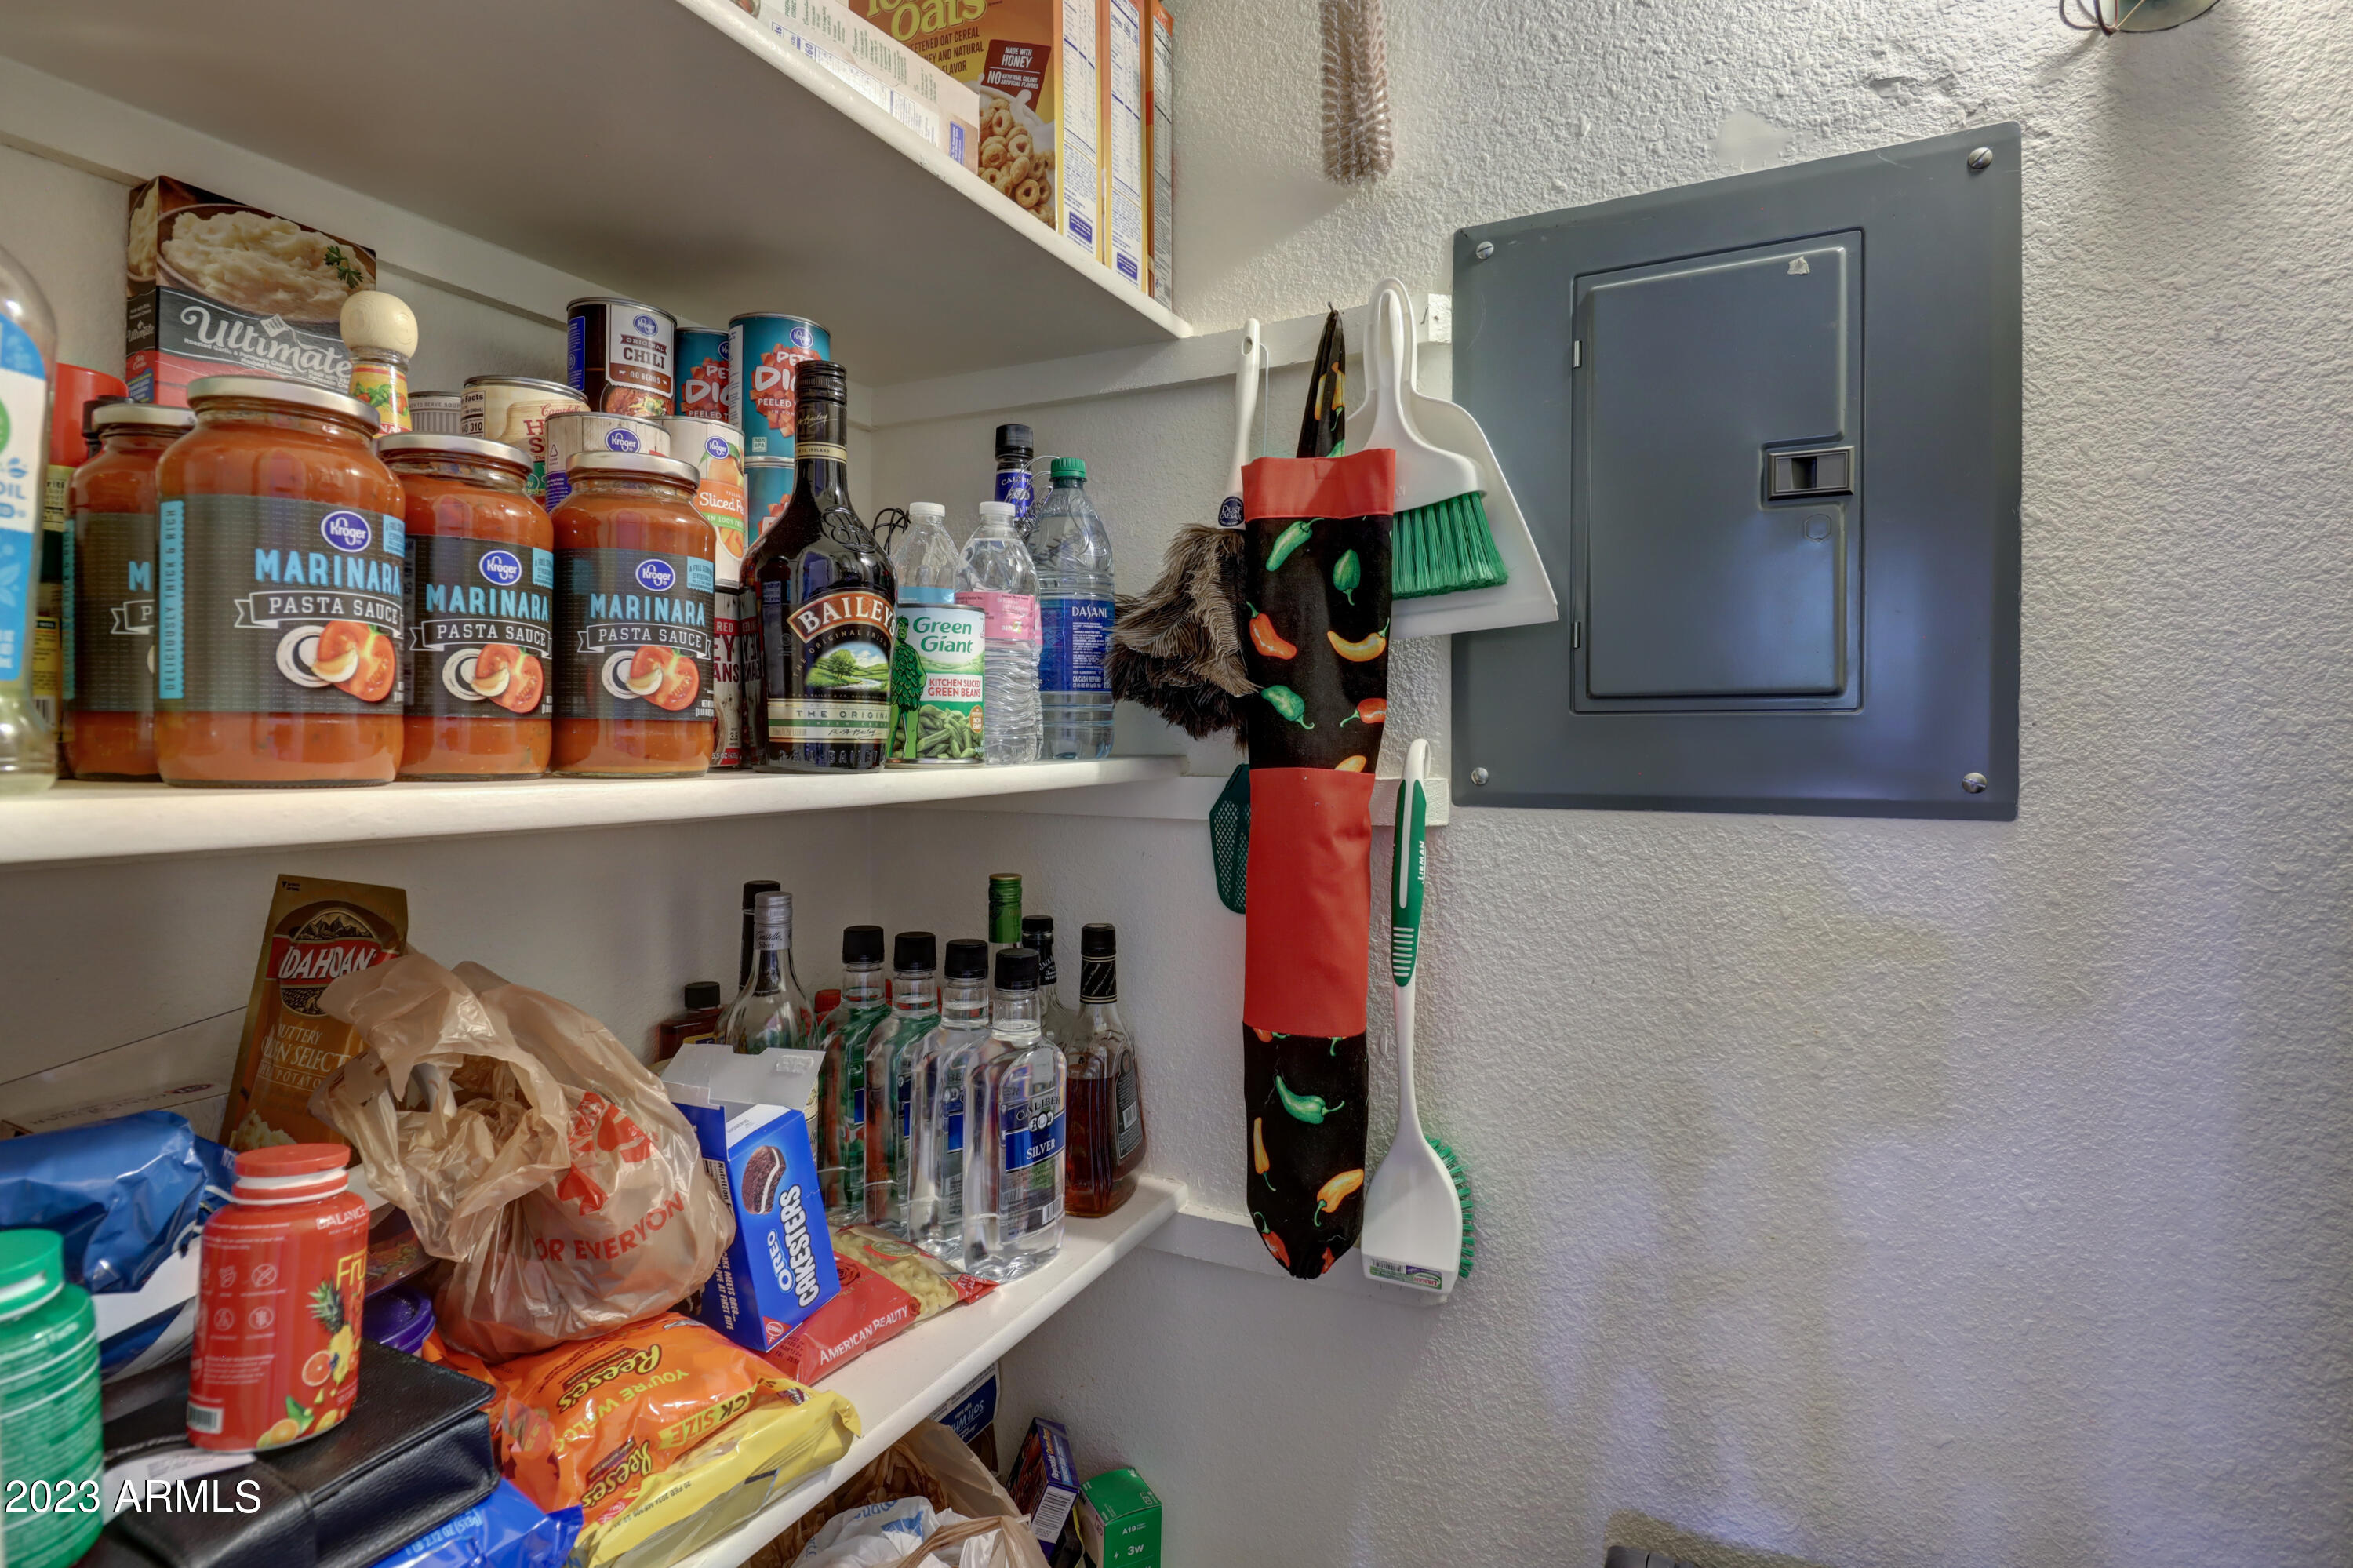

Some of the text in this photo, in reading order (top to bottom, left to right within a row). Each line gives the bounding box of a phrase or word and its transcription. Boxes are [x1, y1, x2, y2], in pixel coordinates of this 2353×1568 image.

[891, 0, 987, 42] Oats
[910, 27, 980, 54] EETENED OAT CEREAL
[1005, 46, 1032, 56] MADE WITH
[922, 42, 984, 64] NEY AND NATURAL
[1001, 54, 1034, 69] HONEY
[943, 60, 968, 75] FLAVOR
[987, 70, 1002, 85] NO
[637, 316, 656, 334] Kroger
[180, 306, 353, 377] Ultimate
[213, 344, 232, 355] Garlic
[625, 337, 665, 352] ORIGINAL
[792, 329, 811, 347] Kroger
[623, 347, 665, 369] CHILI
[758, 398, 792, 407] PEELED
[688, 409, 722, 420] PEELED
[471, 421, 483, 432] 310
[611, 432, 637, 452] Kroger
[708, 439, 727, 457] Kroger
[699, 492, 736, 511] Sliced
[1221, 504, 1241, 514] DUST
[165, 510, 176, 541] RICH
[1220, 511, 1242, 522] CAESAR
[329, 516, 367, 546] Kroger
[254, 548, 402, 597] MARINARA
[486, 555, 518, 580] Kroger
[641, 564, 672, 588] Kroger
[165, 561, 176, 598] THICK
[269, 596, 398, 625] PASTA SAUCE
[426, 583, 550, 623] MARINARA
[590, 592, 707, 628] MARINARA
[1071, 603, 1107, 620] DASANI
[716, 620, 734, 633] RED
[797, 596, 896, 636] BAILEYS
[912, 617, 973, 635] Green
[436, 623, 547, 647] PASTA SAUCE
[598, 627, 653, 642] PASTA
[665, 629, 702, 649] SAUCE
[809, 629, 862, 655] ORIGINAL
[920, 635, 973, 653] Giant
[165, 606, 176, 690] DELICIOUSLY
[713, 662, 740, 683] ANS
[929, 678, 981, 688] KITCHEN SLICED
[927, 687, 981, 697] GREEN BEANS
[796, 710, 828, 719] THE
[1417, 840, 1427, 885] LIBMAN
[278, 945, 375, 980] IDAHOAN
[290, 1046, 351, 1074] SELECT
[275, 1068, 322, 1087] POTATO
[1016, 1096, 1061, 1122] CALIBER
[1025, 1137, 1056, 1160] SILVER
[717, 1161, 730, 1202] Nutrition
[316, 1206, 367, 1231] BALANCE
[534, 1191, 685, 1261] OR EVERYON
[779, 1184, 820, 1308] CAKESTERS
[766, 1228, 795, 1293] OREO
[724, 1271, 735, 1295] MEETS
[719, 1293, 729, 1314] FIRST
[724, 1315, 734, 1331] BITE
[820, 1324, 873, 1366] AMERICAN
[872, 1304, 909, 1331] BEAUTY
[556, 1344, 662, 1414] Reese's
[618, 1368, 690, 1402] YOU'RE
[670, 1409, 715, 1445] SIZE
[580, 1439, 653, 1508] Reese's
[670, 1486, 683, 1498] FEB
[1139, 1492, 1153, 1506] LED
[1122, 1525, 1136, 1536] A19
